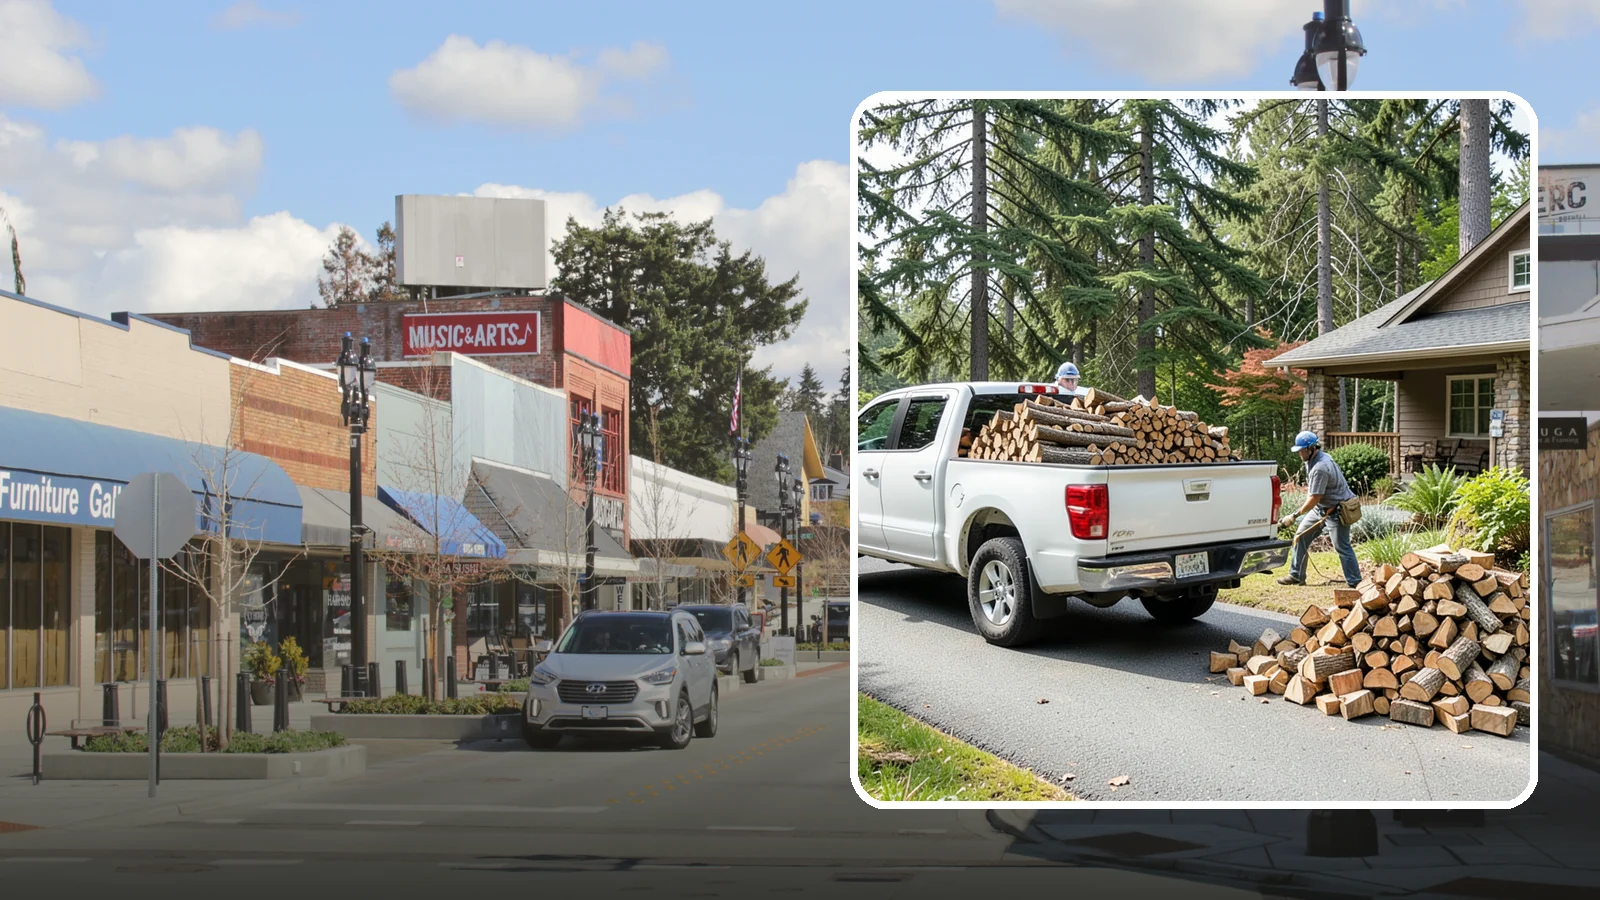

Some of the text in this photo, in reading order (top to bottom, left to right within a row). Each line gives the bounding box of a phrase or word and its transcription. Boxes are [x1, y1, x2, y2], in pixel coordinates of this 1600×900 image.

[0, 472, 121, 519] Furniture Gal
[454, 563, 479, 574] SUSHI
